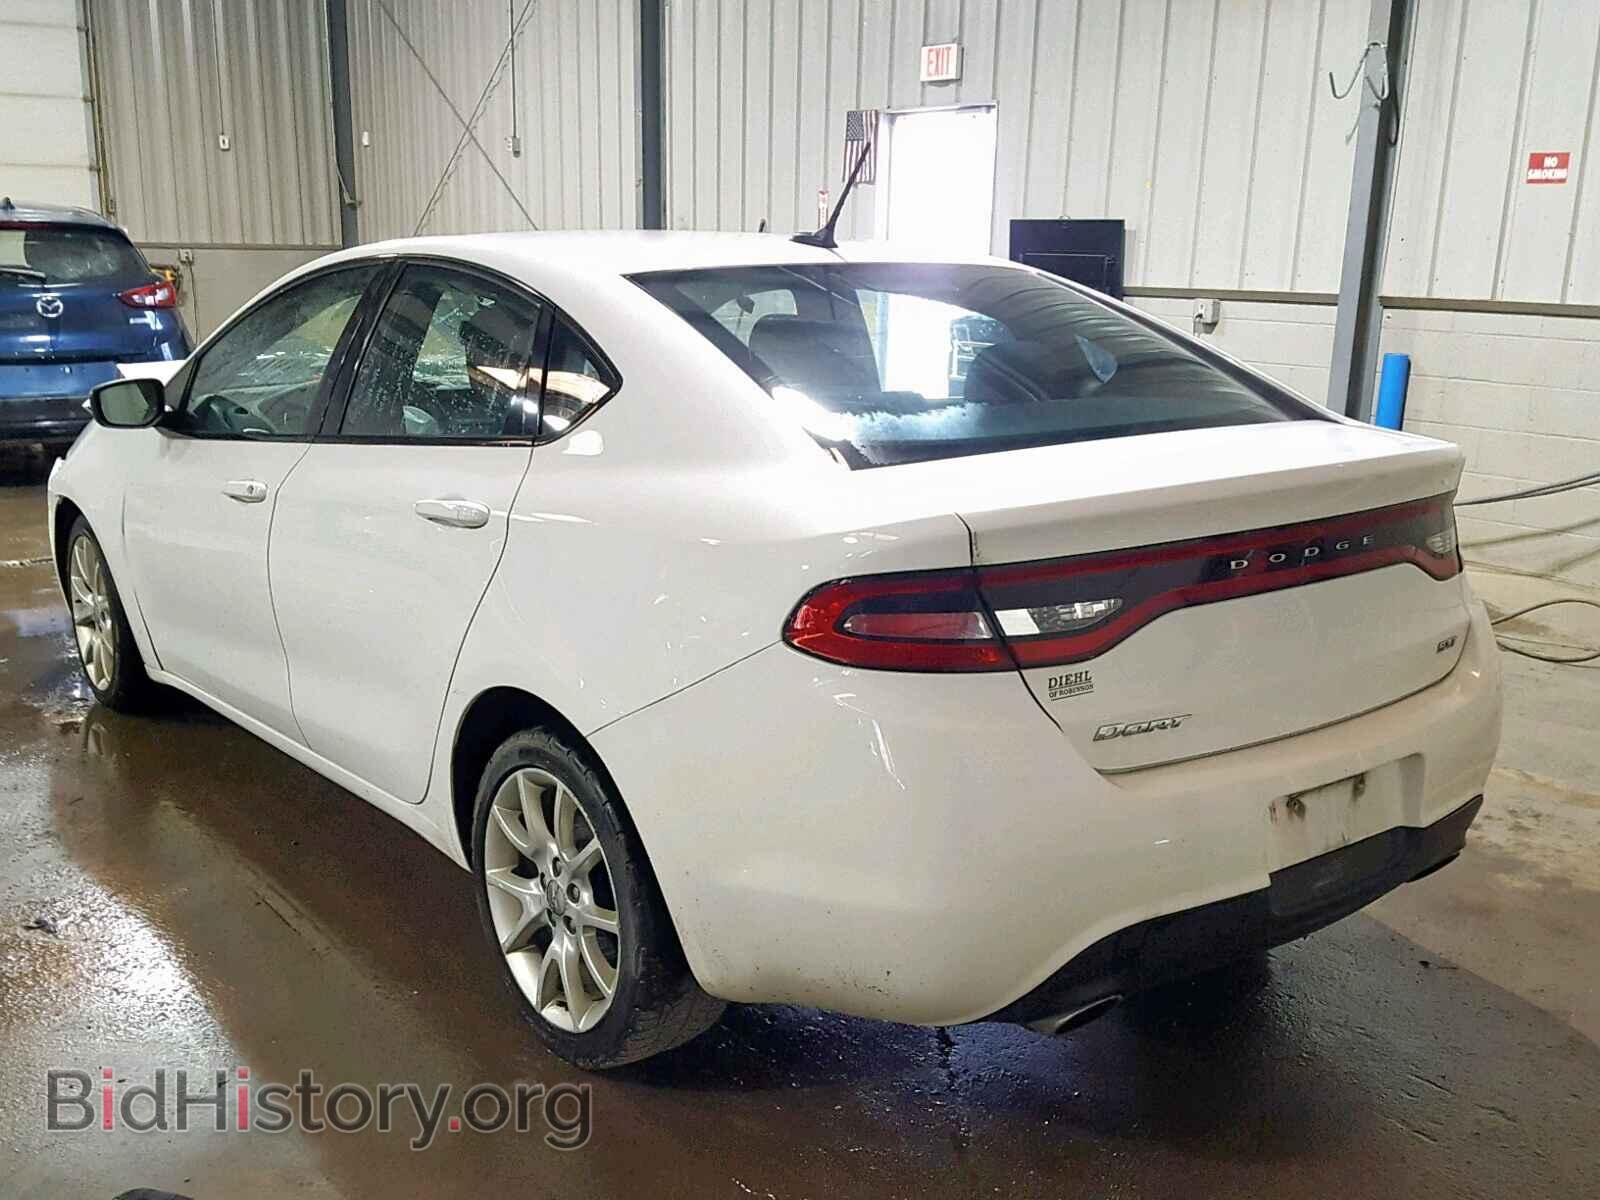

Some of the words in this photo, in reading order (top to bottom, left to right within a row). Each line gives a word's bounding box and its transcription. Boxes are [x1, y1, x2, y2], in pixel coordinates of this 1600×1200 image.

[928, 47, 952, 77] EXIT
[1543, 156, 1558, 168] NO
[1527, 168, 1568, 180] SMOKING
[1230, 535, 1375, 570] DODGE
[1048, 671, 1093, 688] DIEHL
[1093, 713, 1192, 742] DART
